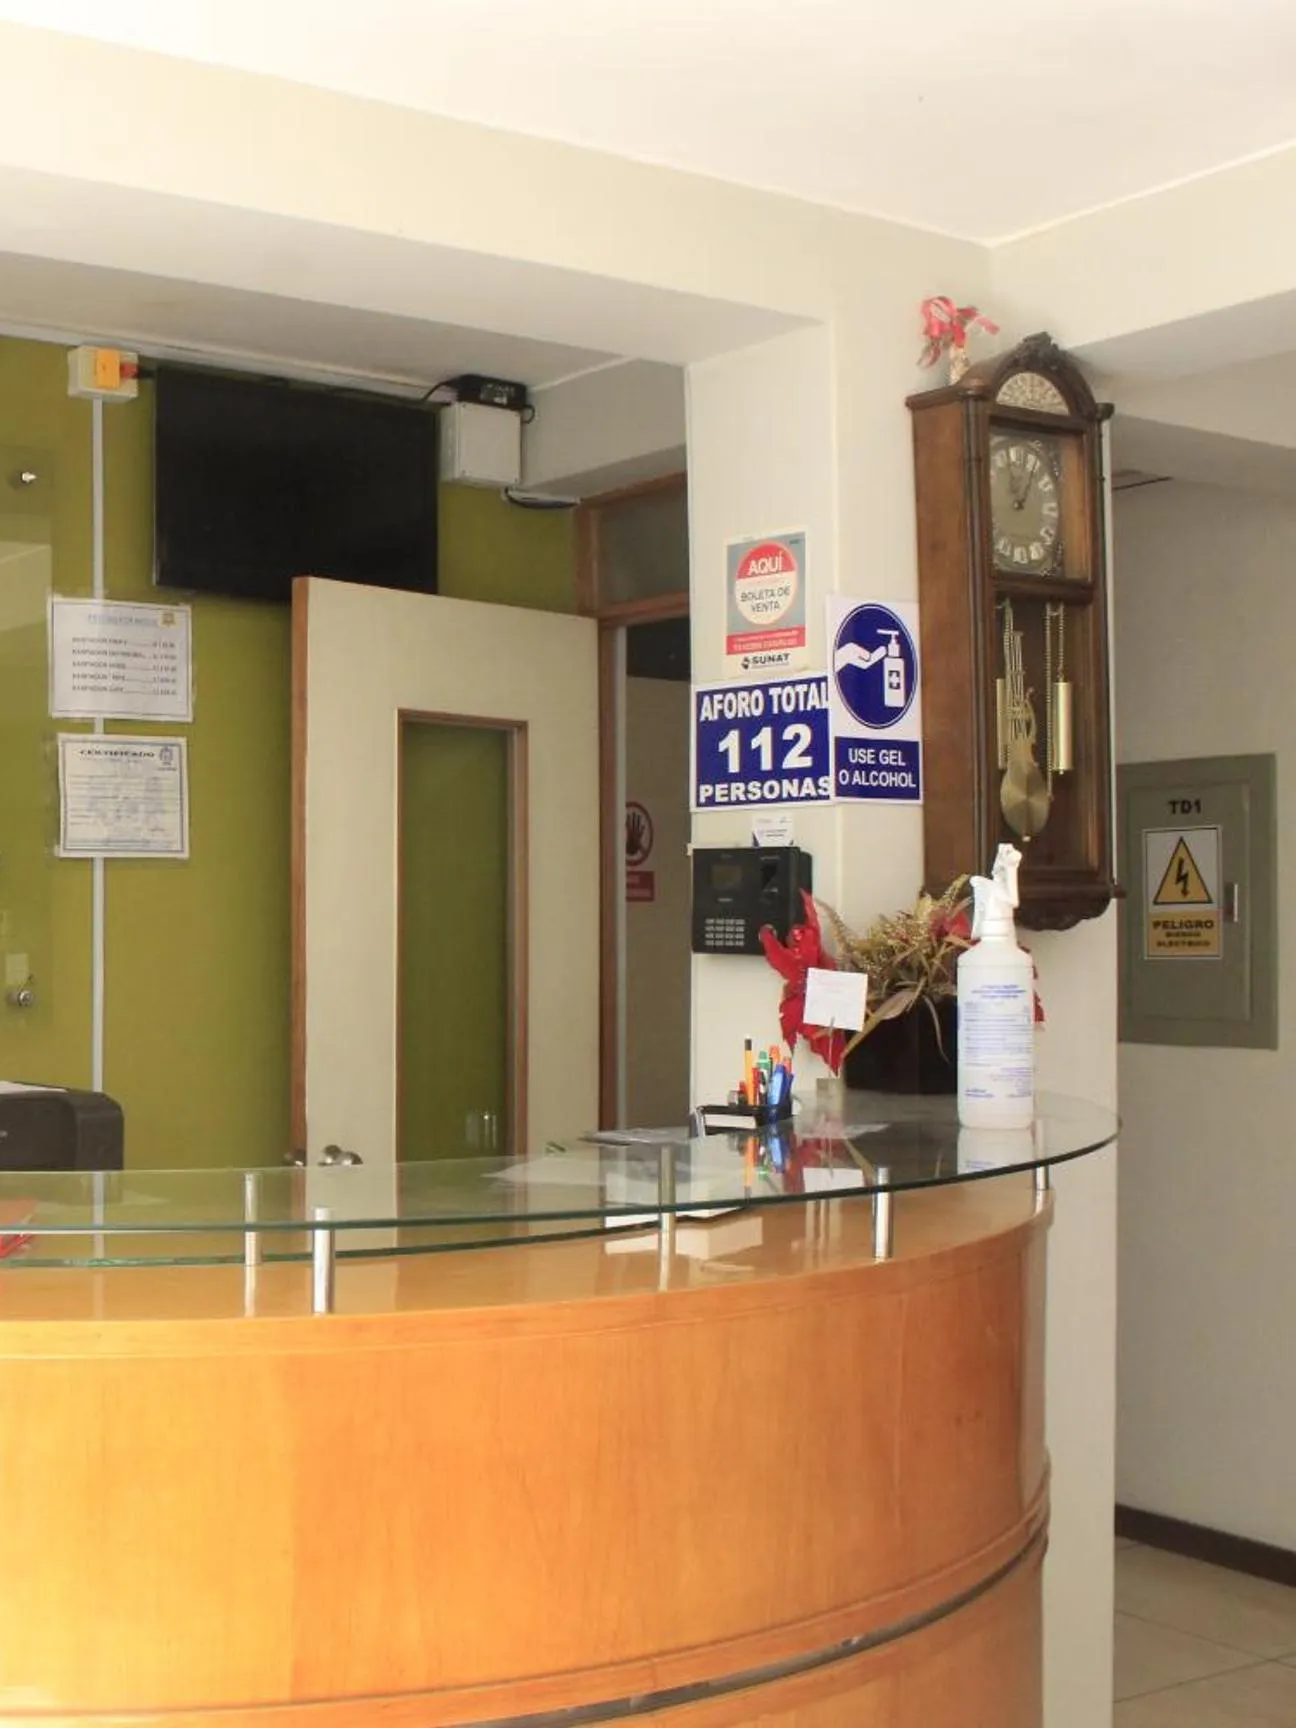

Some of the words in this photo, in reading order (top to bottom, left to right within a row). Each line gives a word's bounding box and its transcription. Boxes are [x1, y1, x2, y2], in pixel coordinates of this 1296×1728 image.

[747, 551, 783, 577] AQUÍ
[751, 600, 780, 613] VENTA
[752, 652, 791, 665] SUNAT
[700, 688, 765, 722] AFORO
[718, 723, 813, 774] 112
[848, 748, 876, 764] USE
[879, 749, 906, 766] GEL
[839, 769, 848, 784] O
[852, 770, 917, 788] ALCOHOL
[698, 775, 830, 804] PERSONAS
[1168, 799, 1202, 815] TD1
[1152, 919, 1214, 930] PELIGRO
